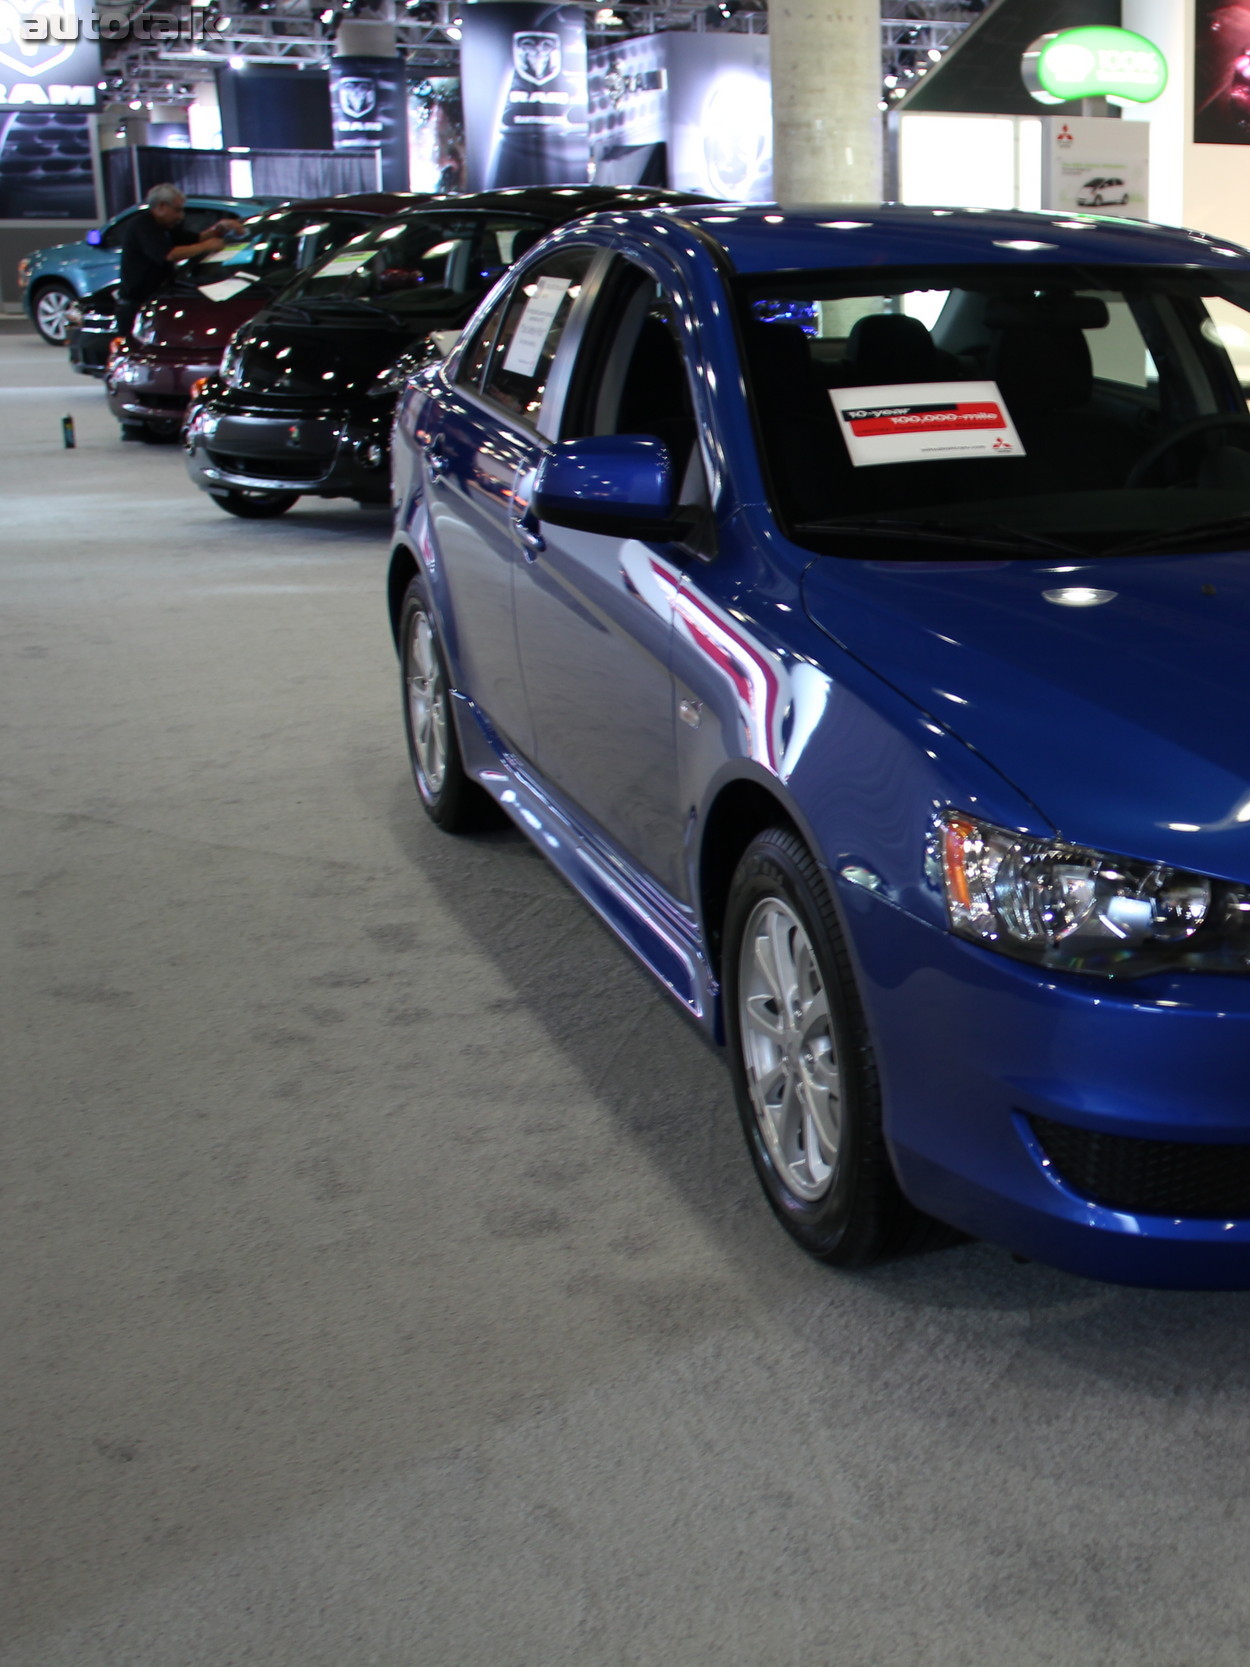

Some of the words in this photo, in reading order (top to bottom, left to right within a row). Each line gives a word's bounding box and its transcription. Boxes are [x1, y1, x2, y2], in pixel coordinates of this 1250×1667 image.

[0, 83, 96, 105] AM
[848, 408, 910, 419] 10-year
[890, 412, 998, 425] 100,000-mile
